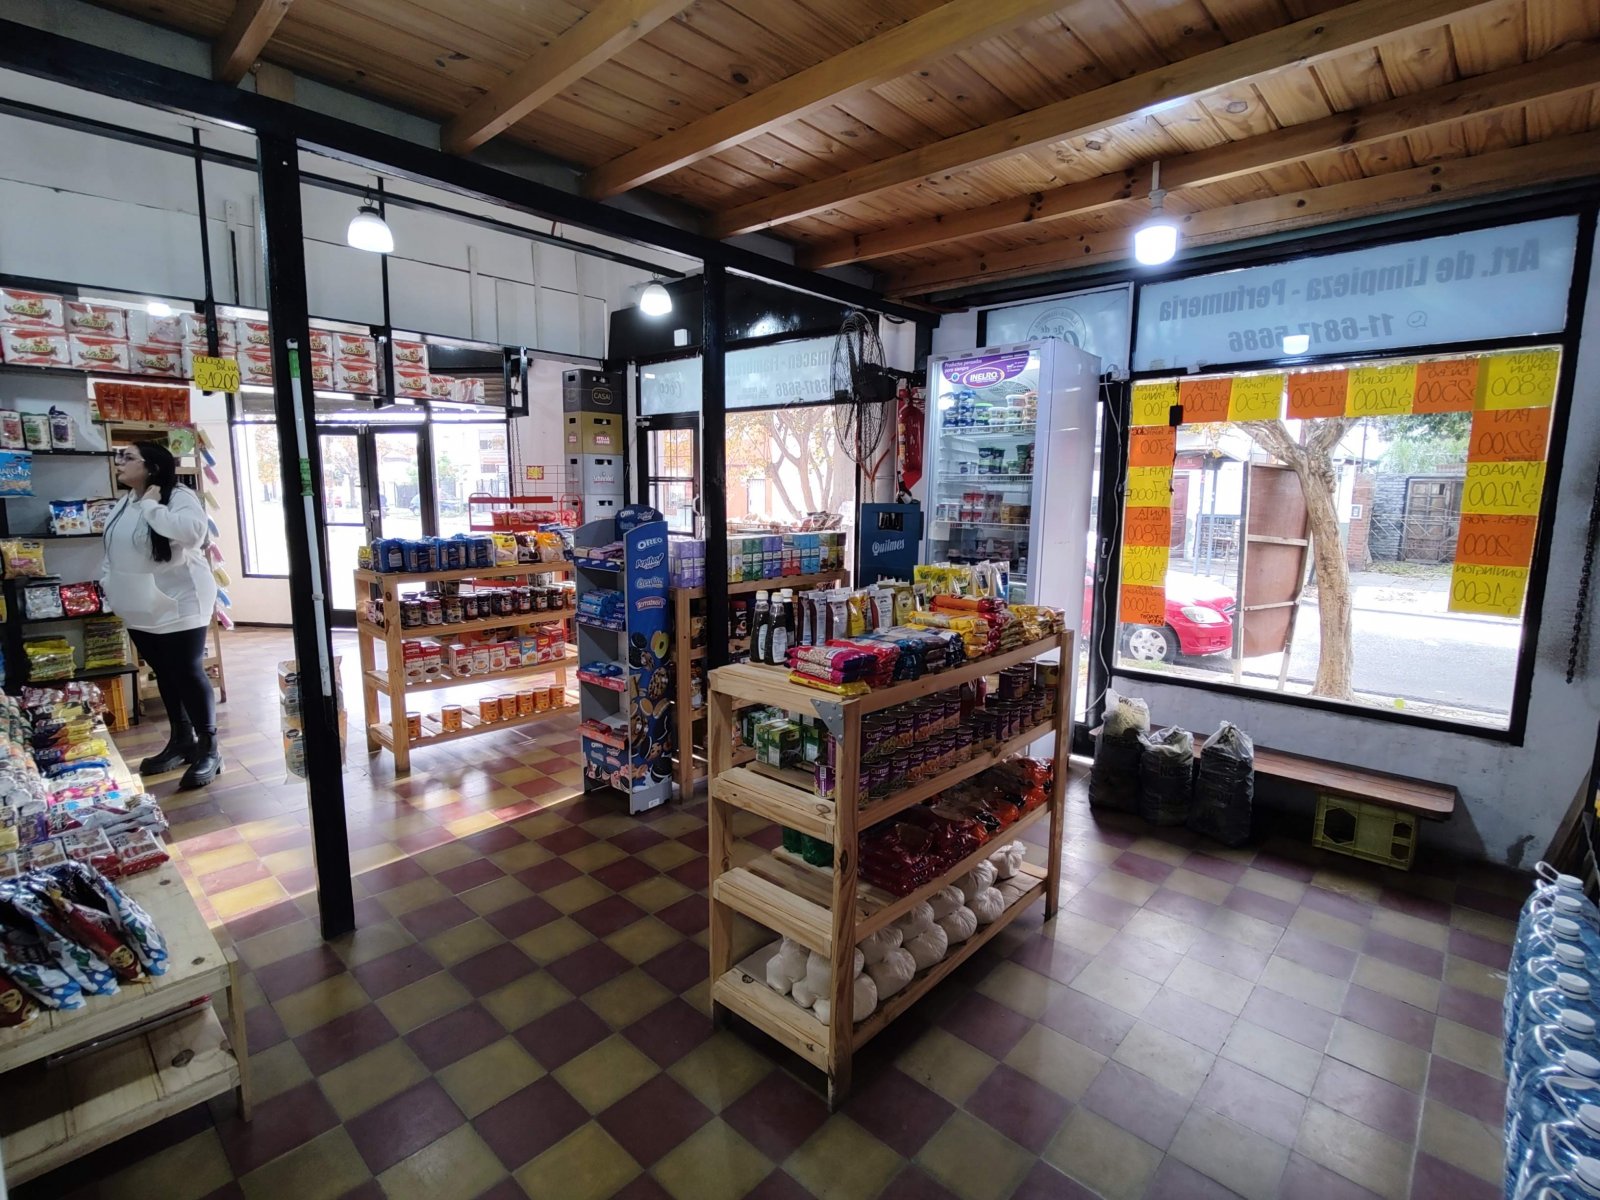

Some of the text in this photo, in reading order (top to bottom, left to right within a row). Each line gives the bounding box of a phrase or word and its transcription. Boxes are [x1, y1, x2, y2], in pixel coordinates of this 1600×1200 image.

[197, 368, 240, 392] $1200
[636, 537, 663, 550] OREO
[872, 538, 905, 556] Quilmes
